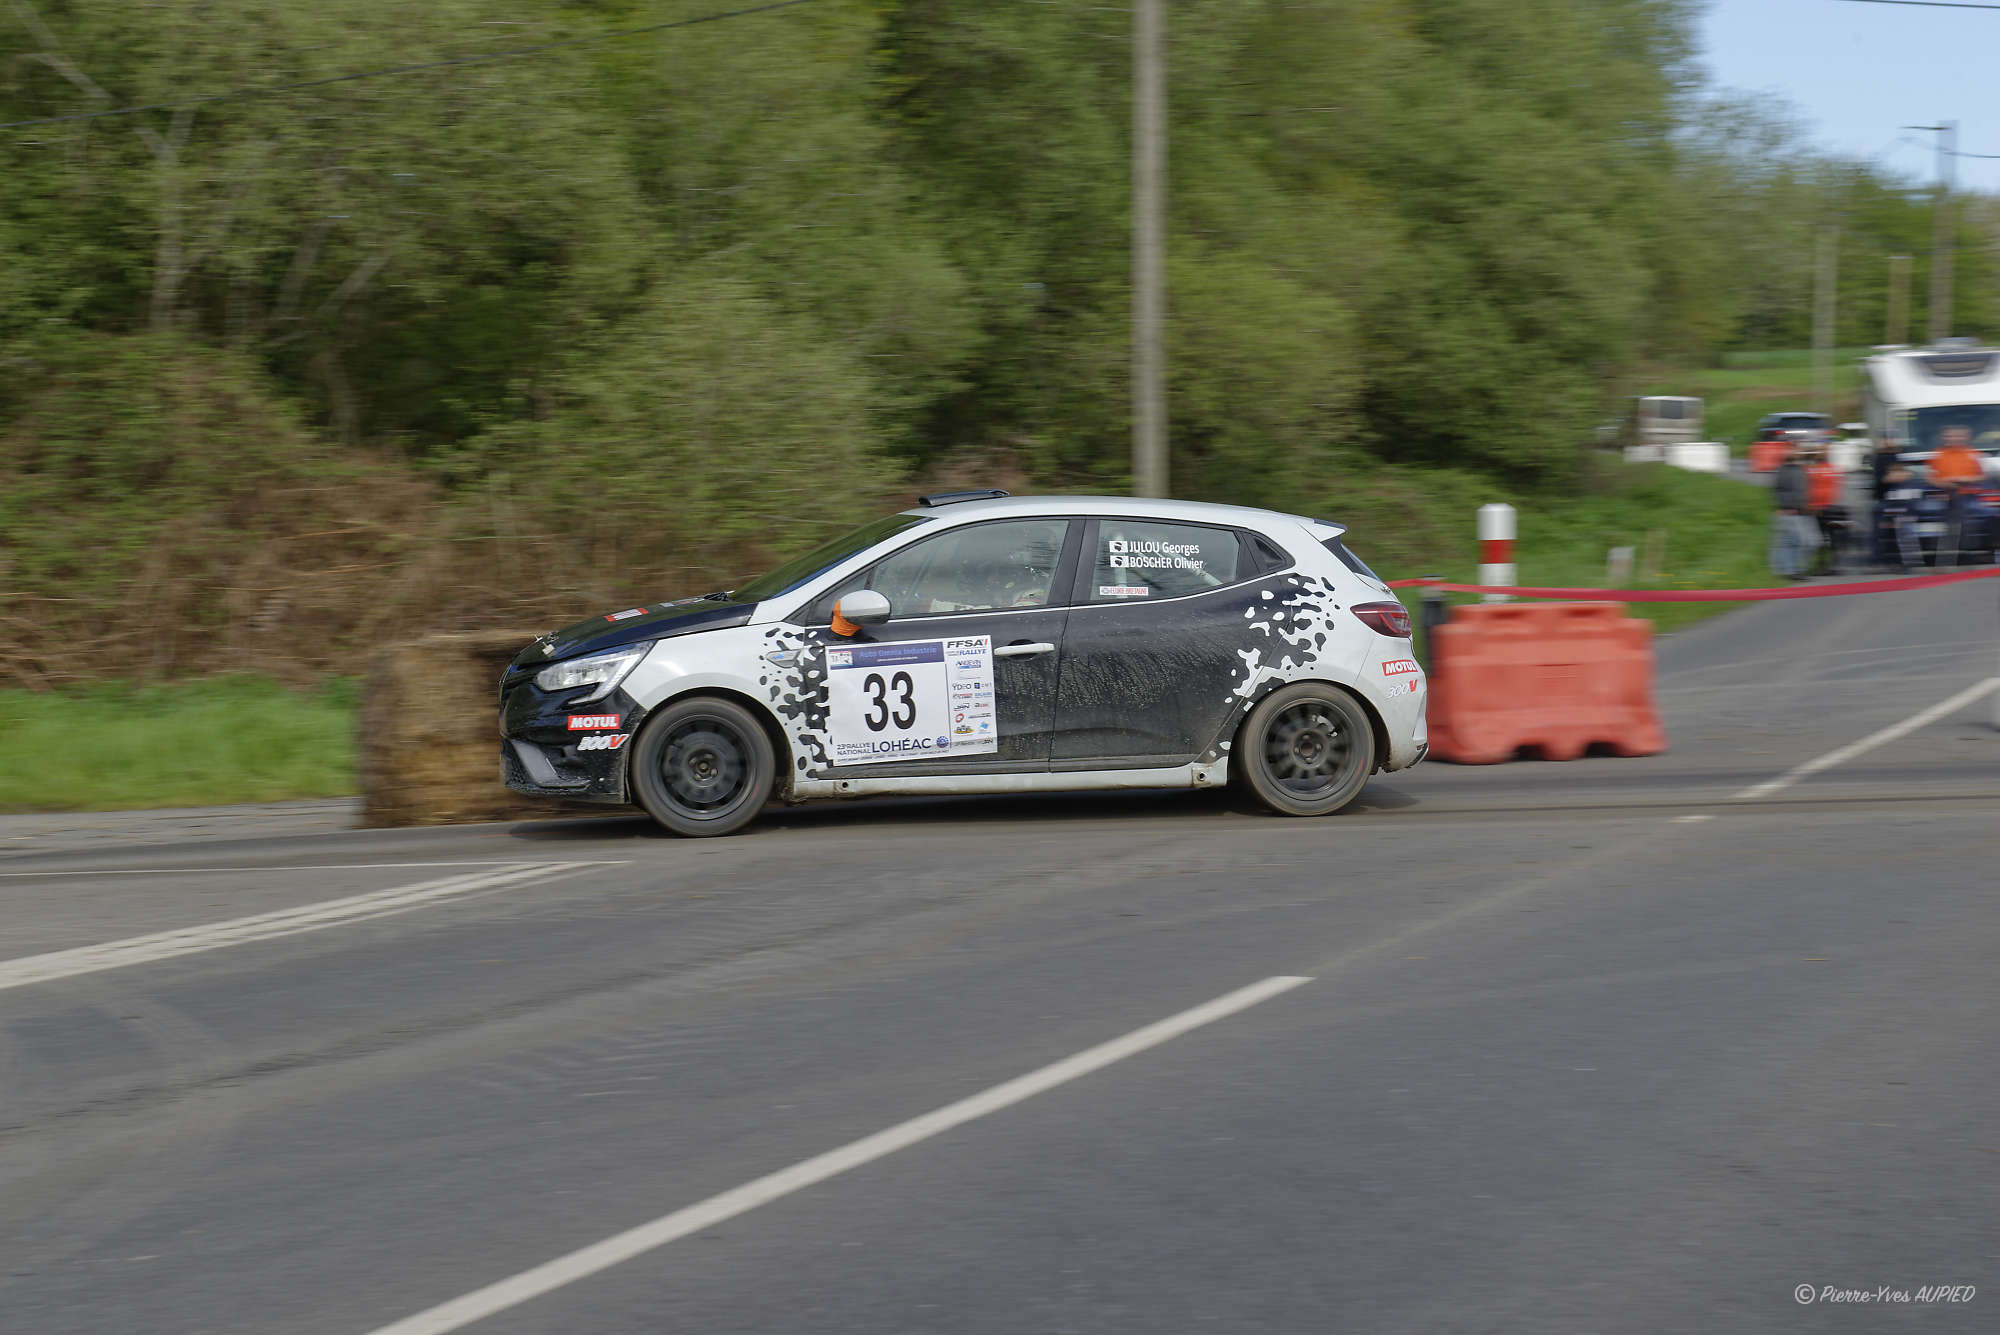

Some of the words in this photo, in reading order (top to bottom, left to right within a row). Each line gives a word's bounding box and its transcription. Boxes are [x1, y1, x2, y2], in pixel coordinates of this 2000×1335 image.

[1130, 541, 1160, 553] JULOU
[1162, 541, 1200, 556] Georges
[1130, 556, 1173, 568] BOSCHER
[1174, 557, 1204, 569] Olivier
[947, 639, 984, 648] FFSA
[1385, 661, 1416, 674] MOTUL
[863, 670, 917, 732] 33
[570, 716, 618, 729] MOTUL
[577, 733, 630, 751] 300V
[872, 738, 932, 753] LOHÉAC
